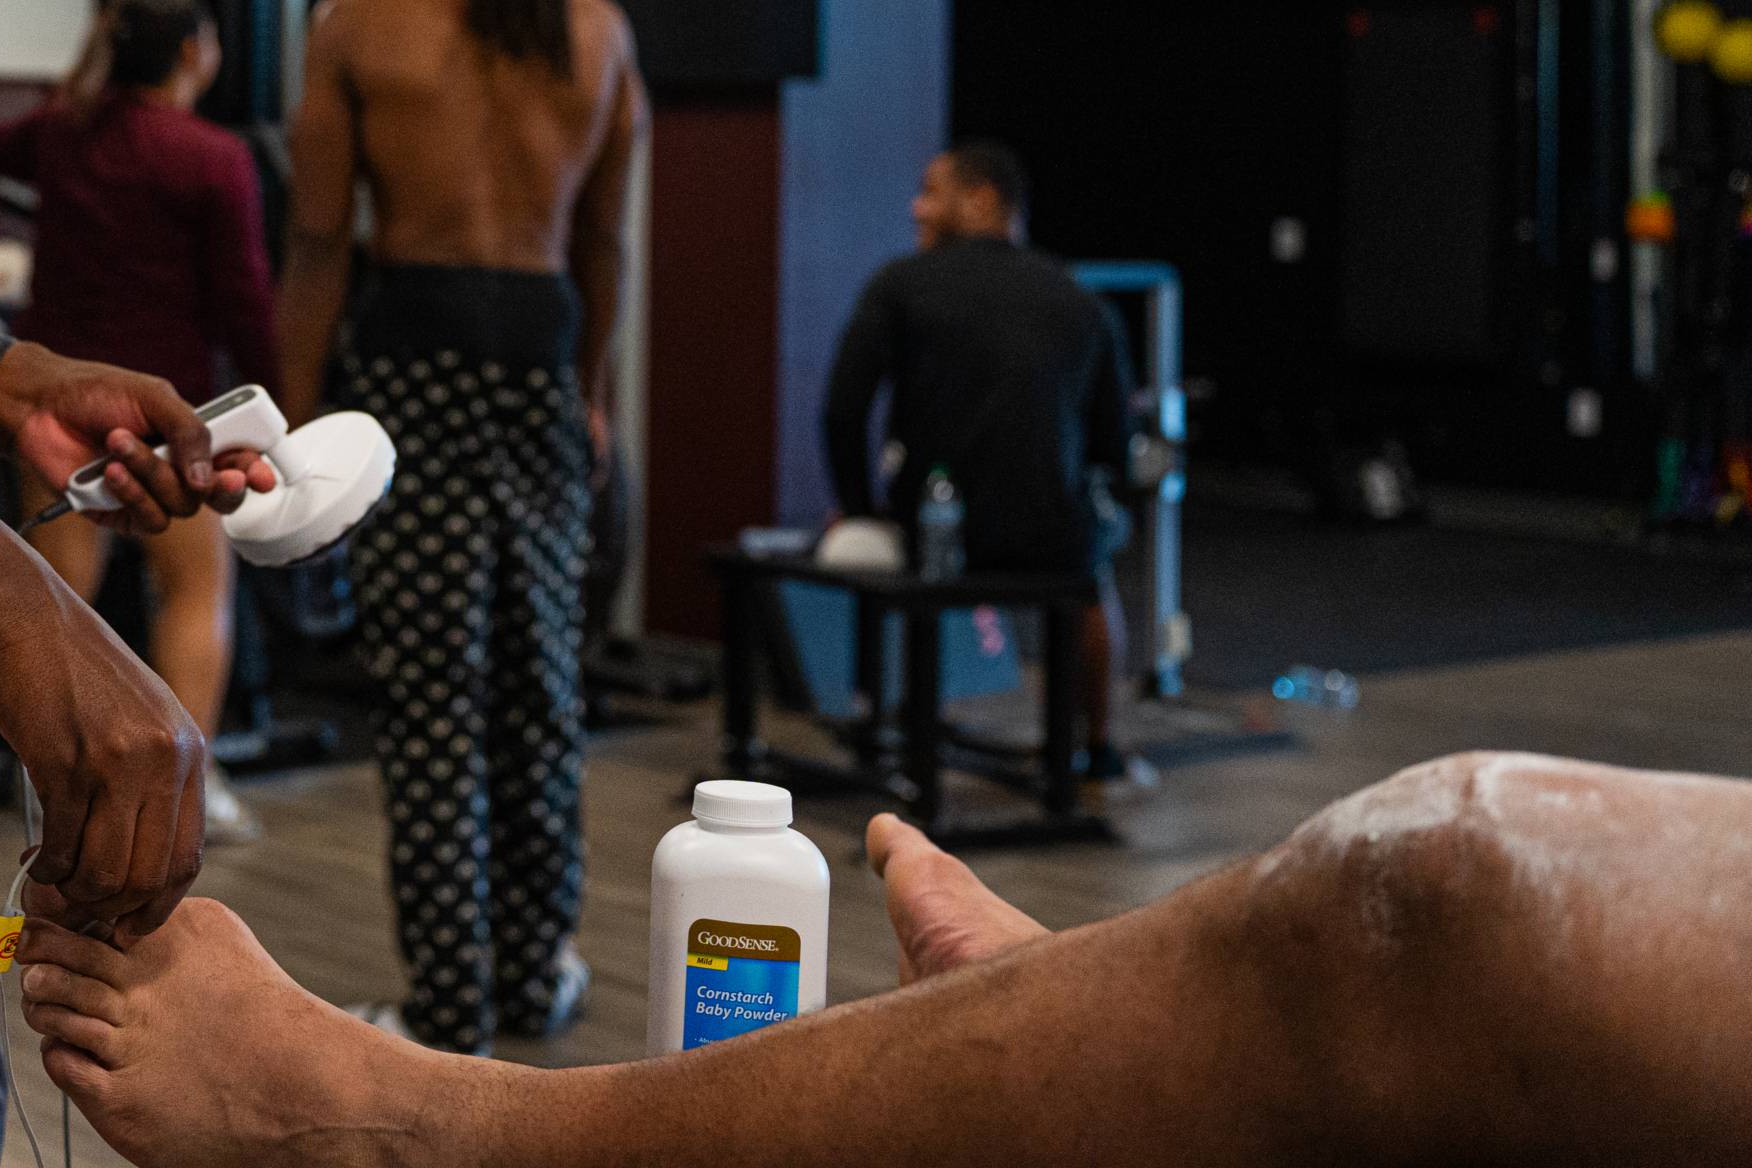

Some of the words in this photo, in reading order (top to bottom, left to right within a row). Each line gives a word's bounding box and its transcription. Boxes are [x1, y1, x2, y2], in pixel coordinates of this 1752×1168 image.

[696, 957, 713, 966] Mild
[697, 985, 773, 1005] Cornstarch
[696, 1001, 731, 1020] Baby
[734, 1006, 788, 1022] Powder
